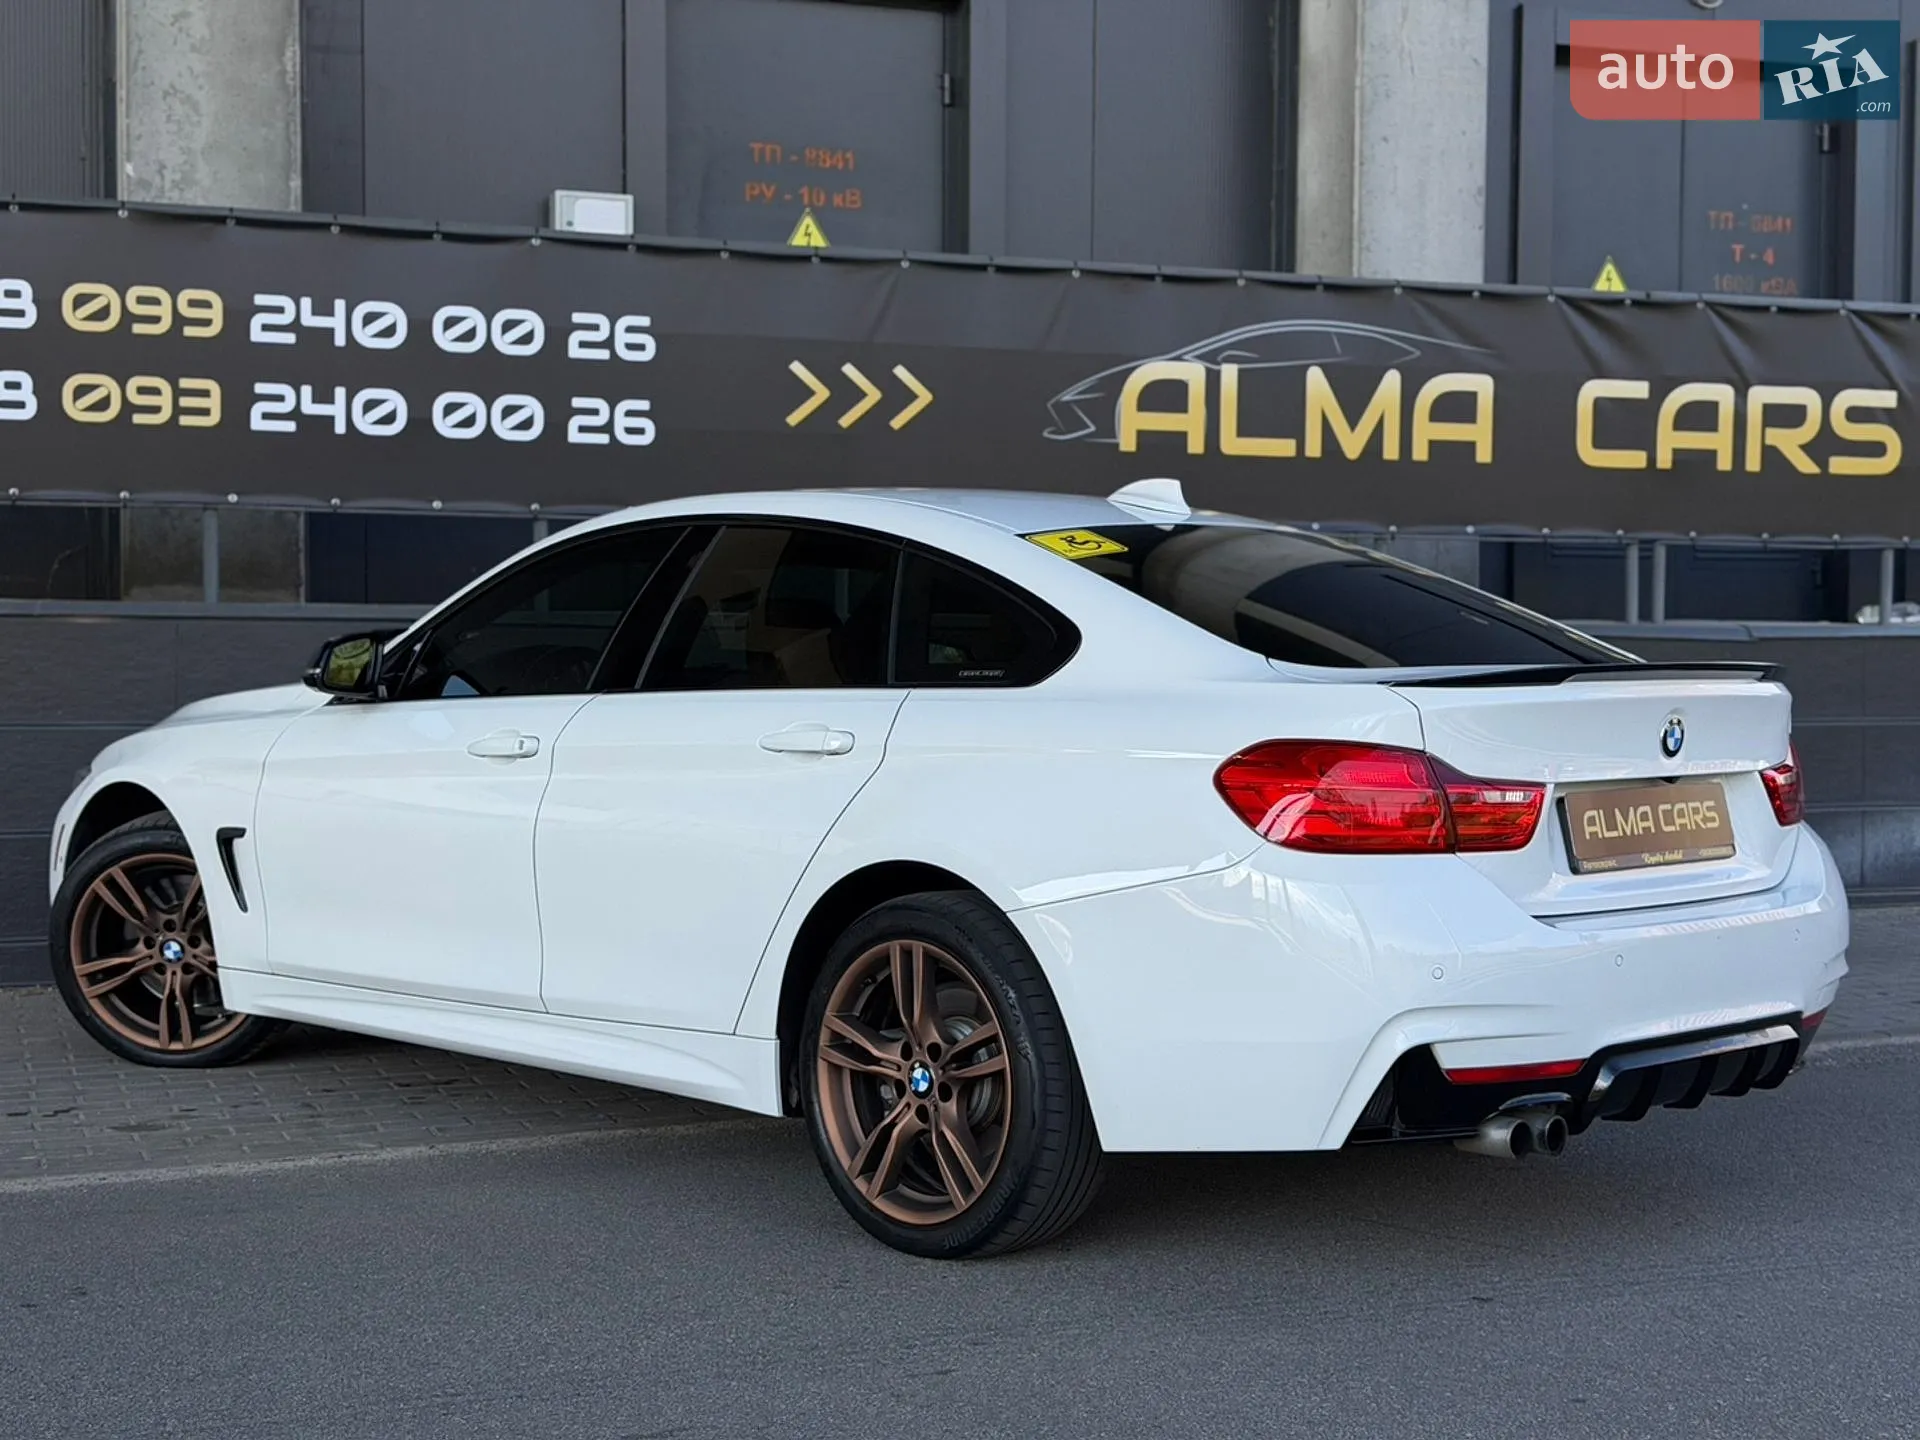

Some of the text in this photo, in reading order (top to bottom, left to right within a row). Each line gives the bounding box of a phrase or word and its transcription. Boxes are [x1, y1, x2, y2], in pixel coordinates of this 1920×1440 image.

[61, 282, 224, 338] 099
[250, 293, 408, 350] 240
[432, 305, 545, 356] 00
[567, 312, 657, 362] 26
[61, 373, 223, 427] 093
[250, 382, 408, 436] 240
[432, 391, 545, 442] 00
[567, 396, 656, 446] 26
[1118, 361, 1902, 476] ALMA CARS
[1583, 800, 1720, 840] ALMA CARS
